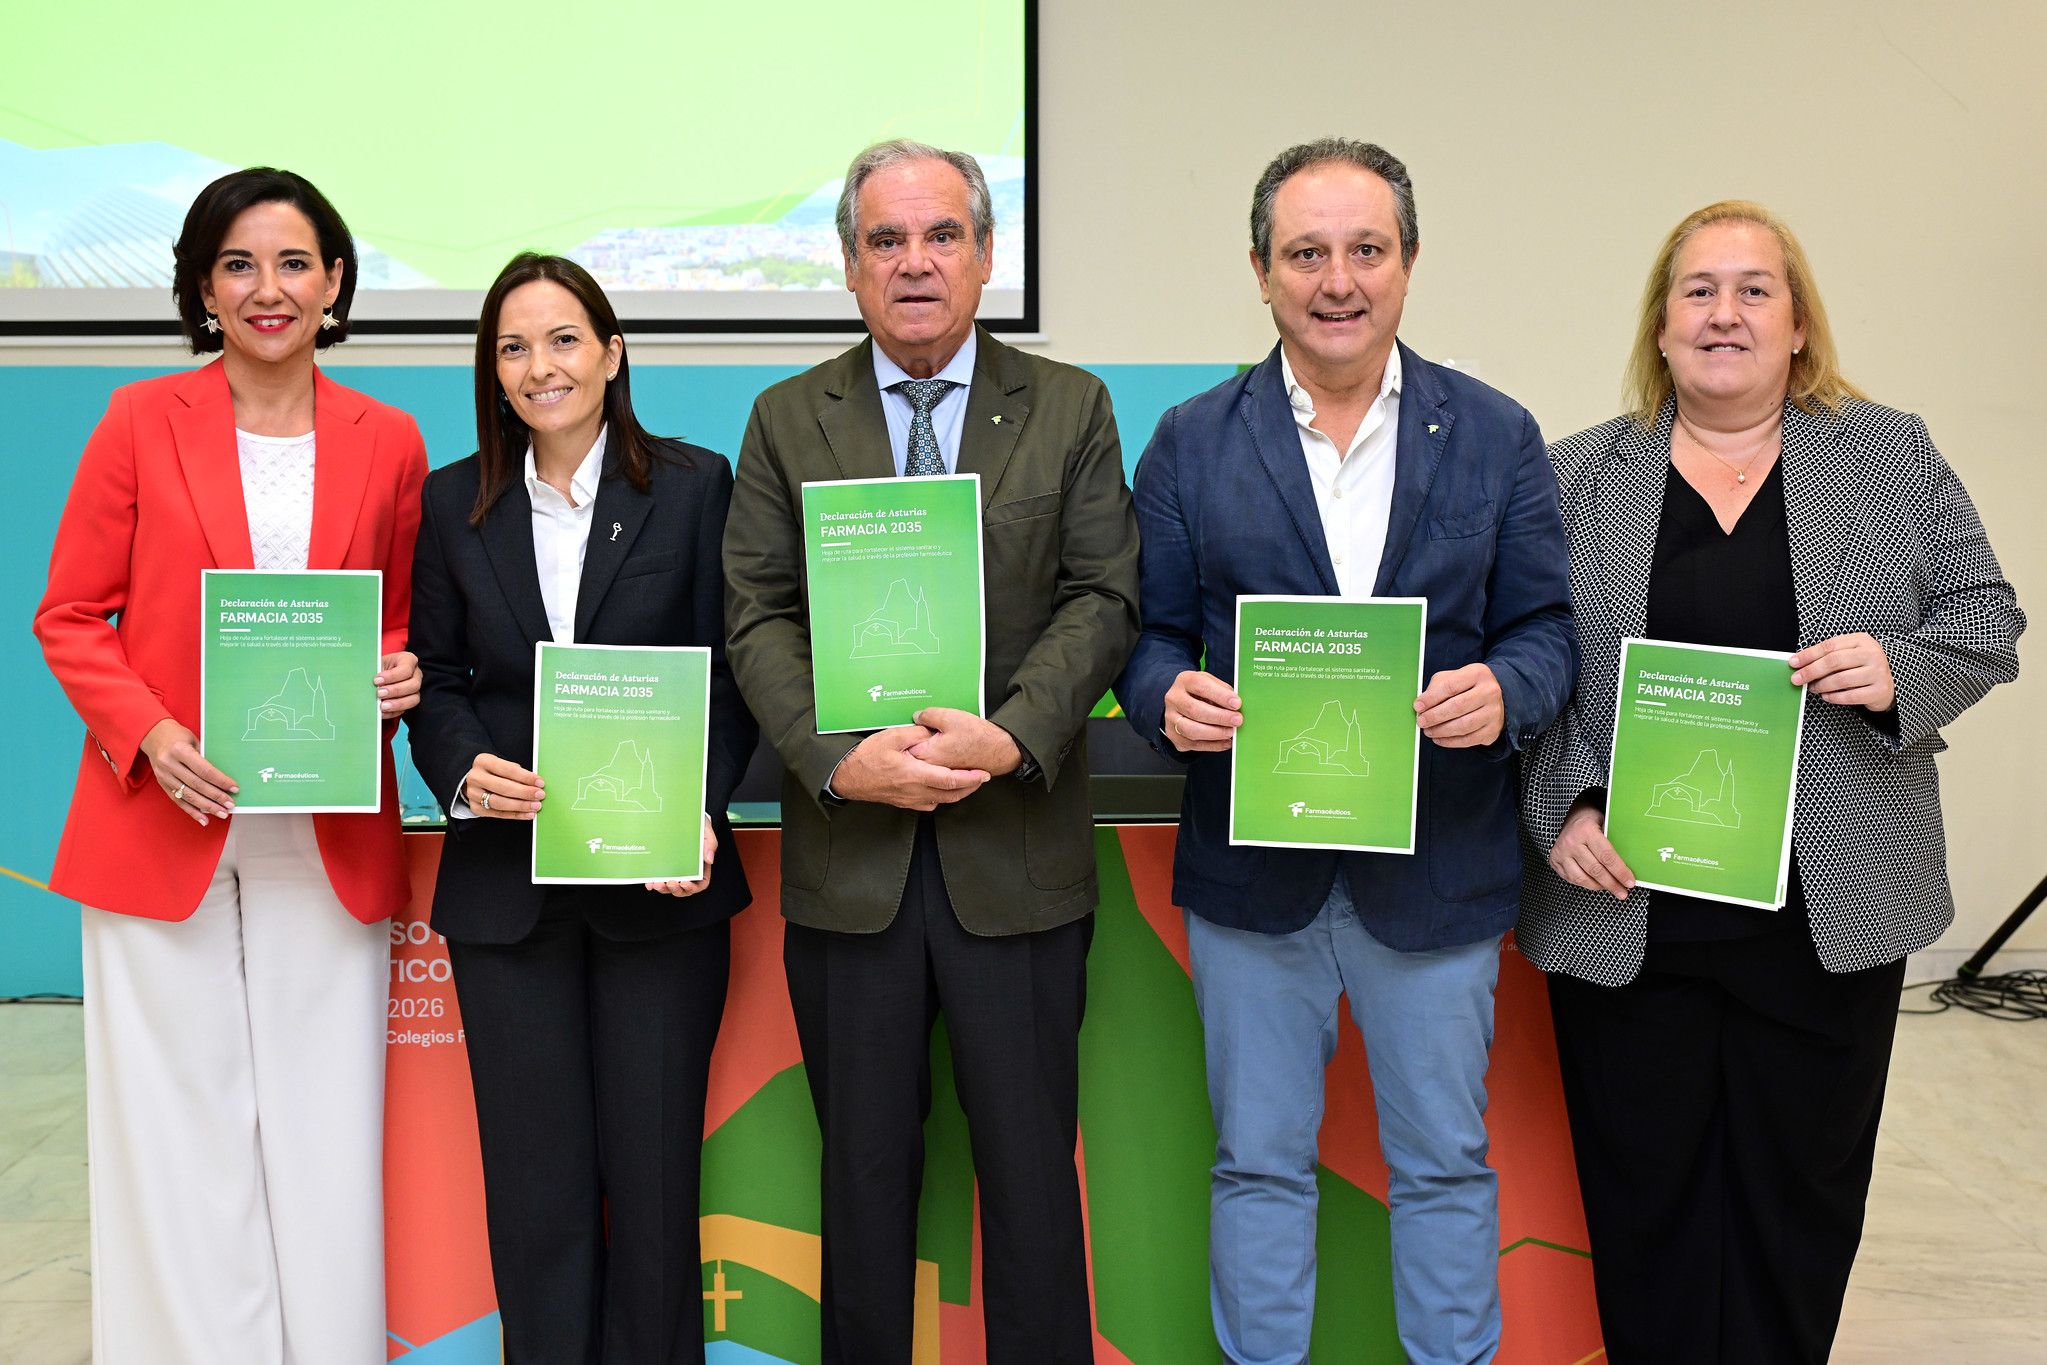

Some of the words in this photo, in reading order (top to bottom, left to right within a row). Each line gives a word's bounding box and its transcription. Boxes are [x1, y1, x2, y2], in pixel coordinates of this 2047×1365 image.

[820, 511, 873, 521] Declaración
[876, 510, 886, 518] de
[889, 508, 927, 517] Asturias
[821, 524, 887, 537] FARMACIA
[891, 522, 921, 533] 2035
[220, 599, 274, 608] Declaración
[278, 599, 287, 608] de
[290, 600, 329, 608] Asturias
[220, 612, 288, 623] FARMACIA
[292, 613, 323, 623] 2035
[1255, 628, 1311, 637] Declaración
[1314, 629, 1324, 637] de
[1327, 629, 1368, 638] Asturias
[1255, 641, 1324, 653] FARMACIA
[1329, 643, 1361, 654] 2035
[555, 672, 607, 681] Declaración
[610, 674, 619, 682] de
[622, 674, 658, 683] Asturias
[1639, 670, 1694, 684] Declaración
[1697, 677, 1707, 685] de
[1709, 678, 1749, 690] Asturias
[555, 684, 619, 696] FARMACIA
[623, 687, 653, 697] 2035
[883, 688, 926, 696] Farmacéuticos
[1638, 683, 1705, 701] FARMACIA
[1709, 692, 1742, 706] 2035
[1674, 854, 1718, 865] Farmacéuticos
[388, 998, 444, 1018] 2026
[387, 1029, 454, 1047] Colegios
